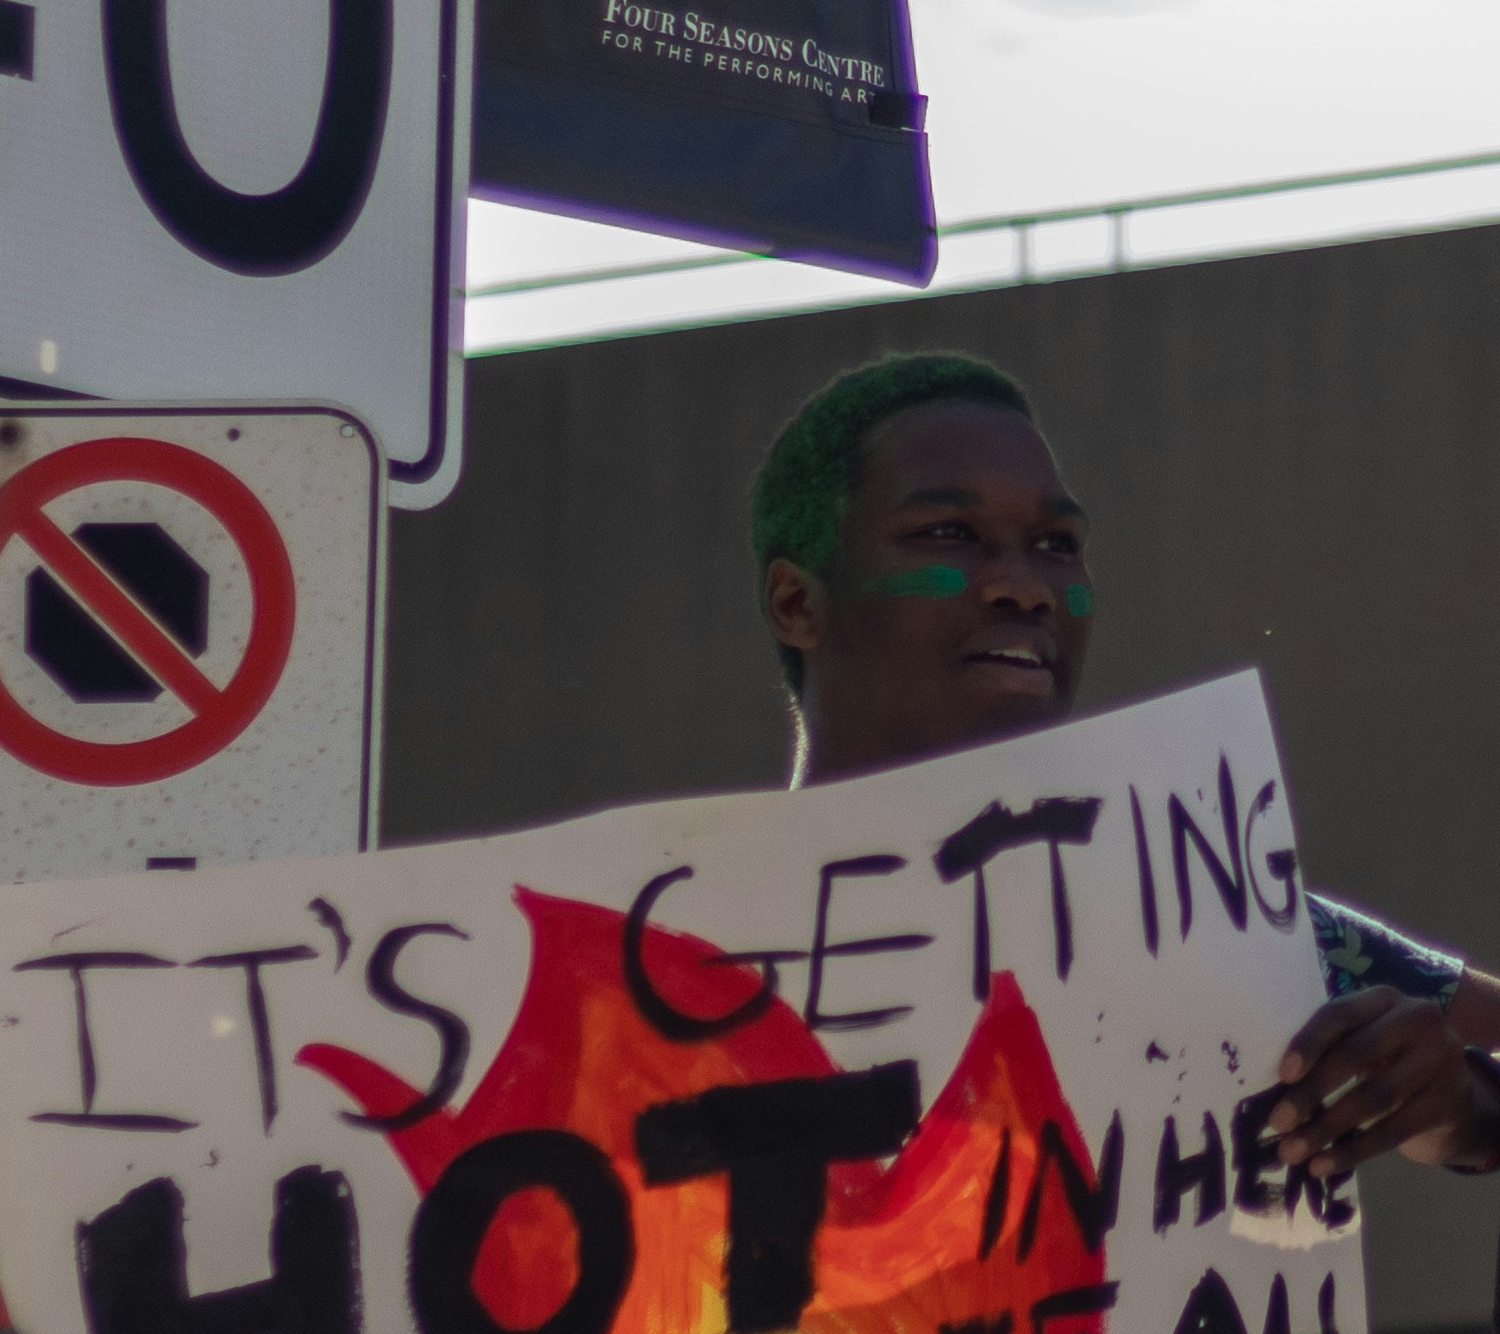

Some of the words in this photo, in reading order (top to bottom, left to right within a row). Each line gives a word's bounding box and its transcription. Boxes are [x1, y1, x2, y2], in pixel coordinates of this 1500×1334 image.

[602, 30, 643, 53] FOR
[655, 41, 692, 64] THE
[704, 53, 833, 97] PERFORMING
[13, 897, 473, 1138] IT'S
[623, 750, 1299, 1044] GETTING
[978, 1108, 1124, 1265] IN
